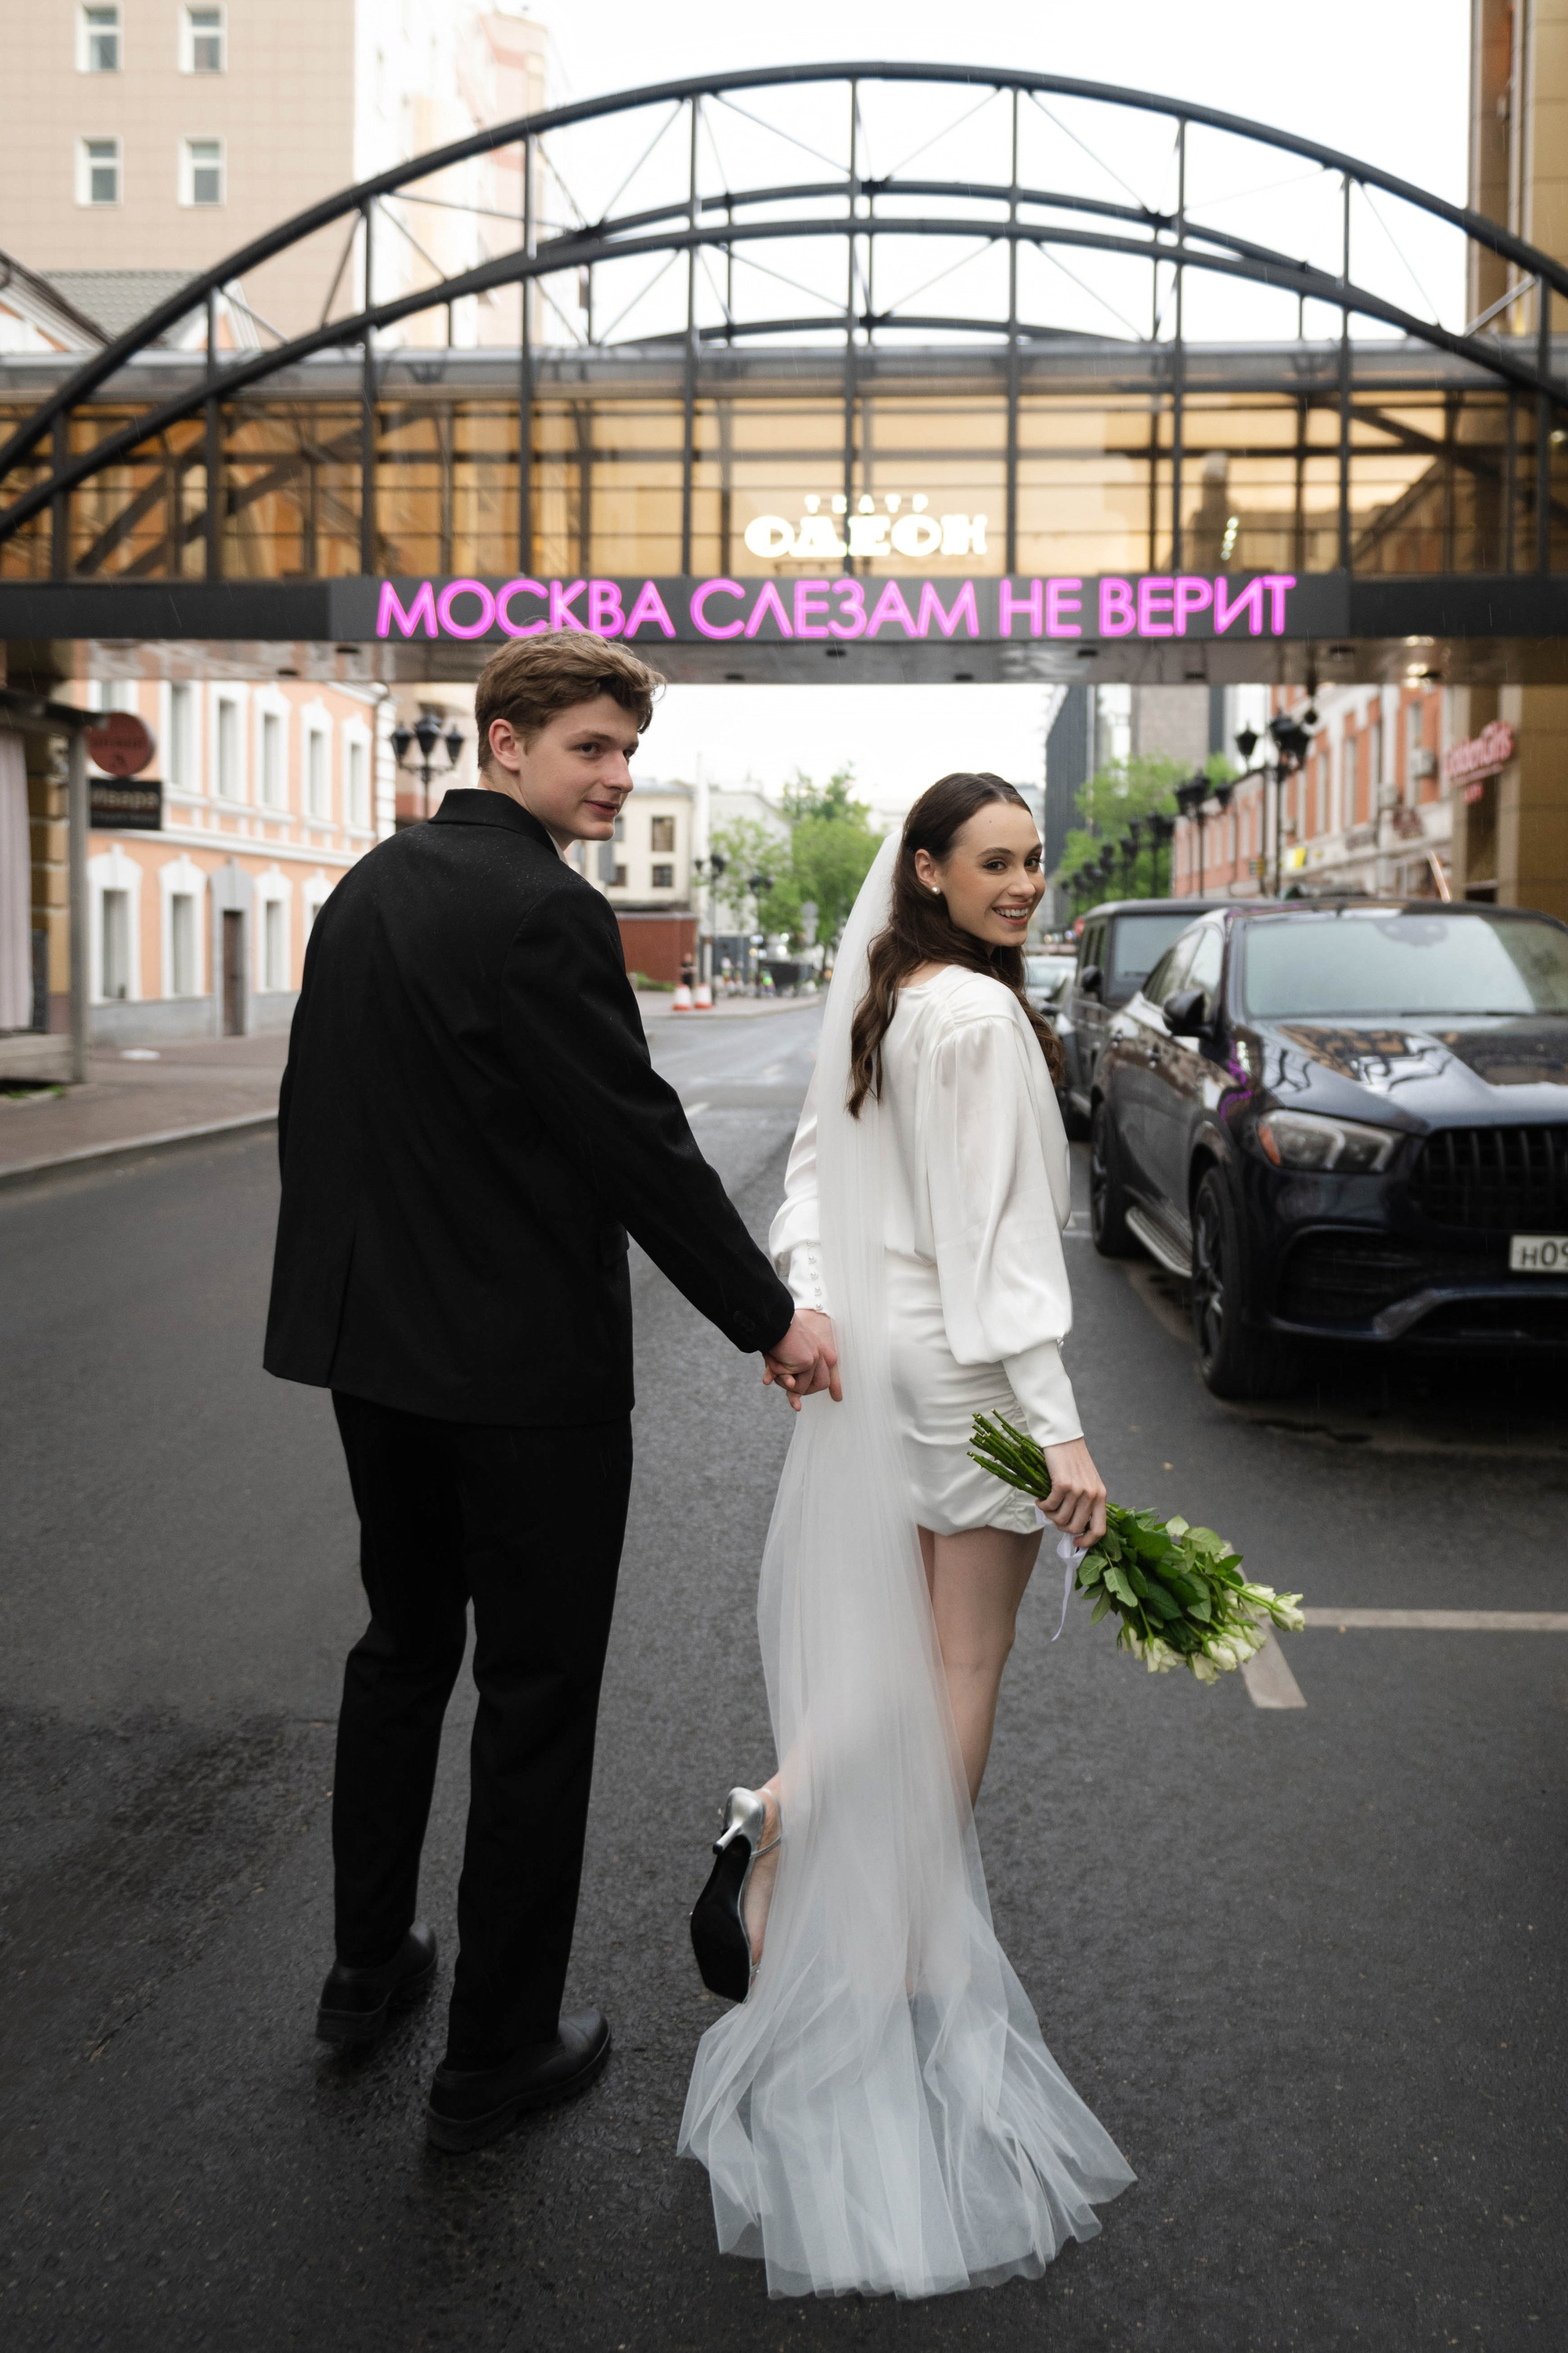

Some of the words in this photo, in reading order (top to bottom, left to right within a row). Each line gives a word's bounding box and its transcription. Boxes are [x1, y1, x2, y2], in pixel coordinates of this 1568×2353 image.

[804, 493, 929, 514] ТЕАТР
[744, 514, 987, 557] ОДЕОН
[375, 578, 676, 639] МОСКВА
[690, 578, 980, 639] СЛЕЗАМ
[999, 578, 1082, 637] НЕ
[1099, 574, 1297, 636] ВЕРИТ
